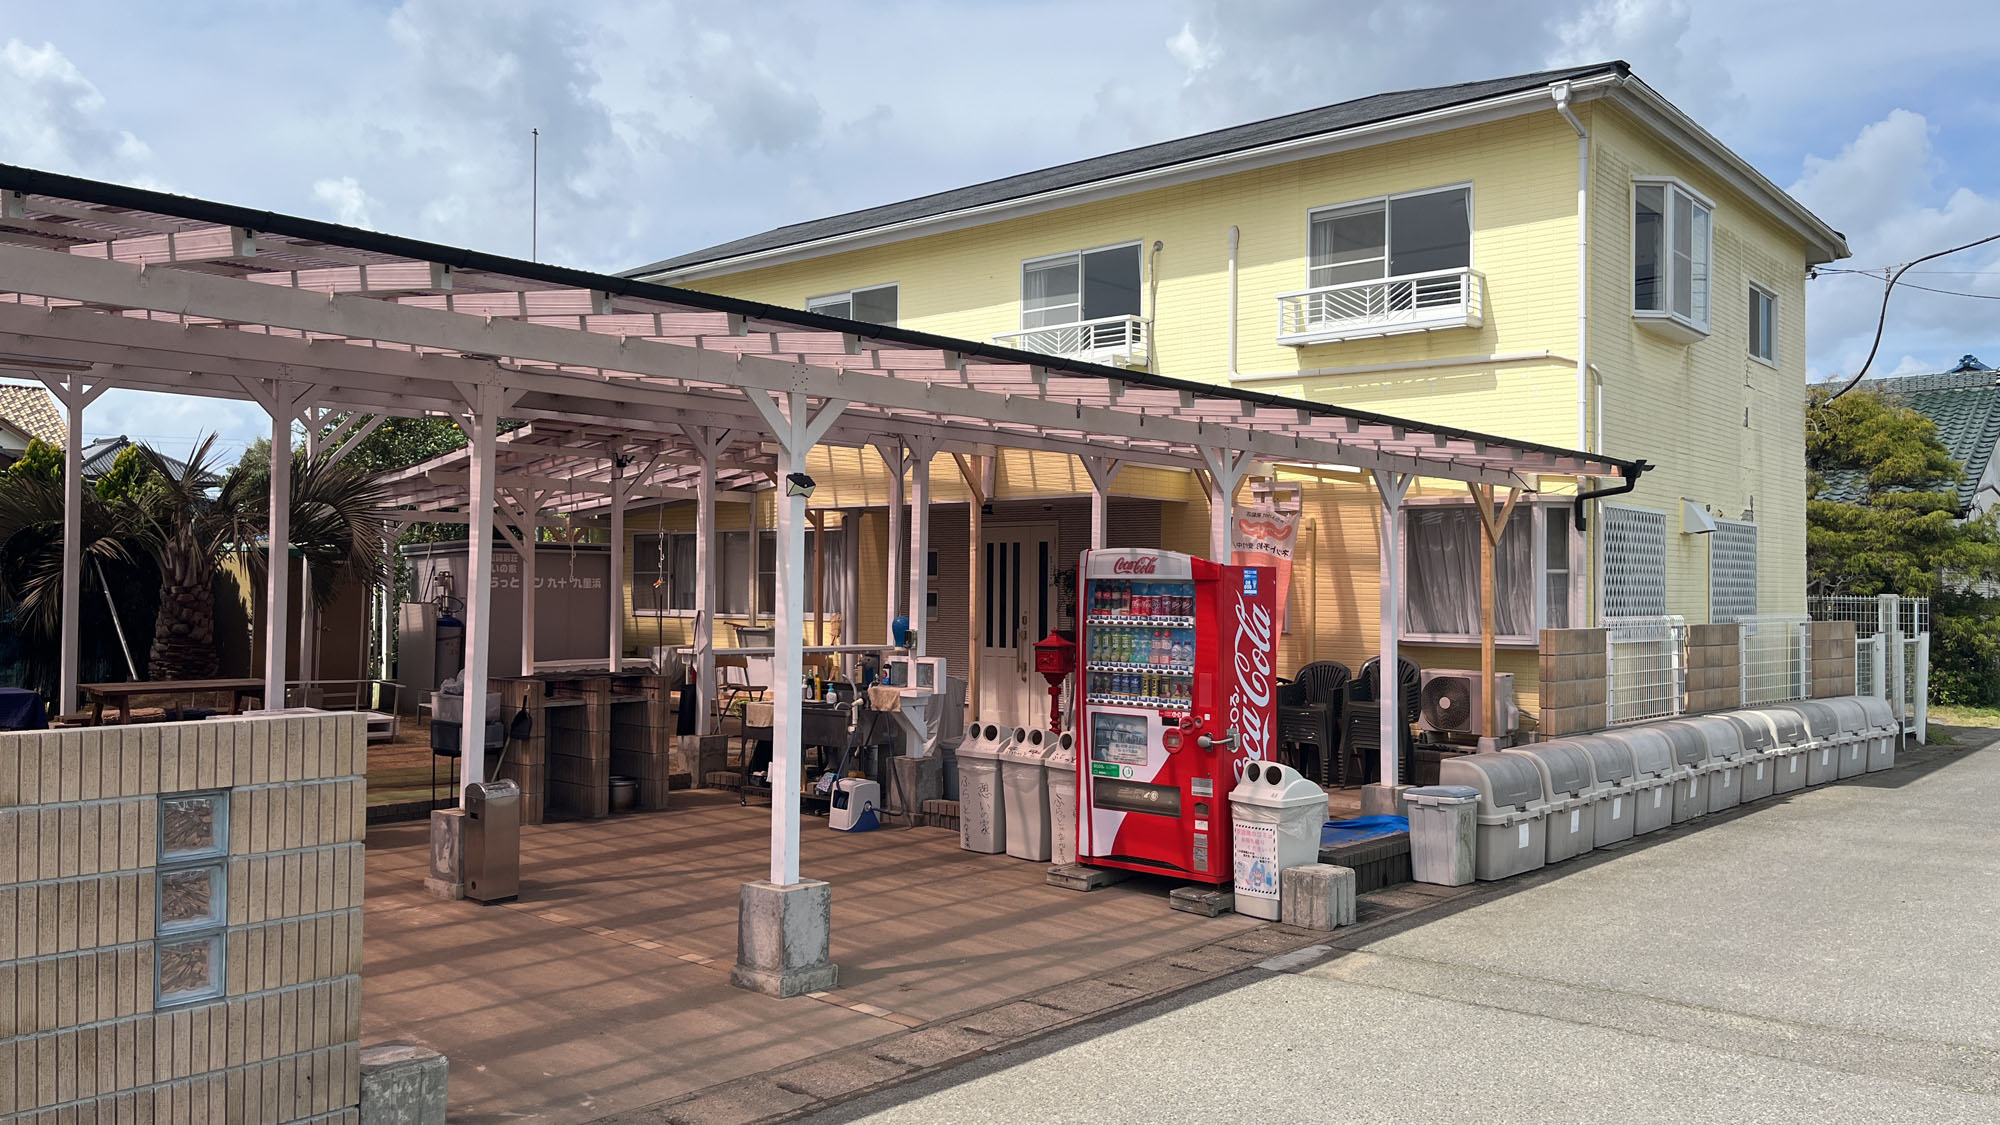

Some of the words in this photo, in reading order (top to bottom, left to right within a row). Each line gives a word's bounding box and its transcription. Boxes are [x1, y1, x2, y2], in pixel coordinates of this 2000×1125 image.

[491, 564, 517, 574] いの家
[1113, 556, 1159, 575] Coca-Cola
